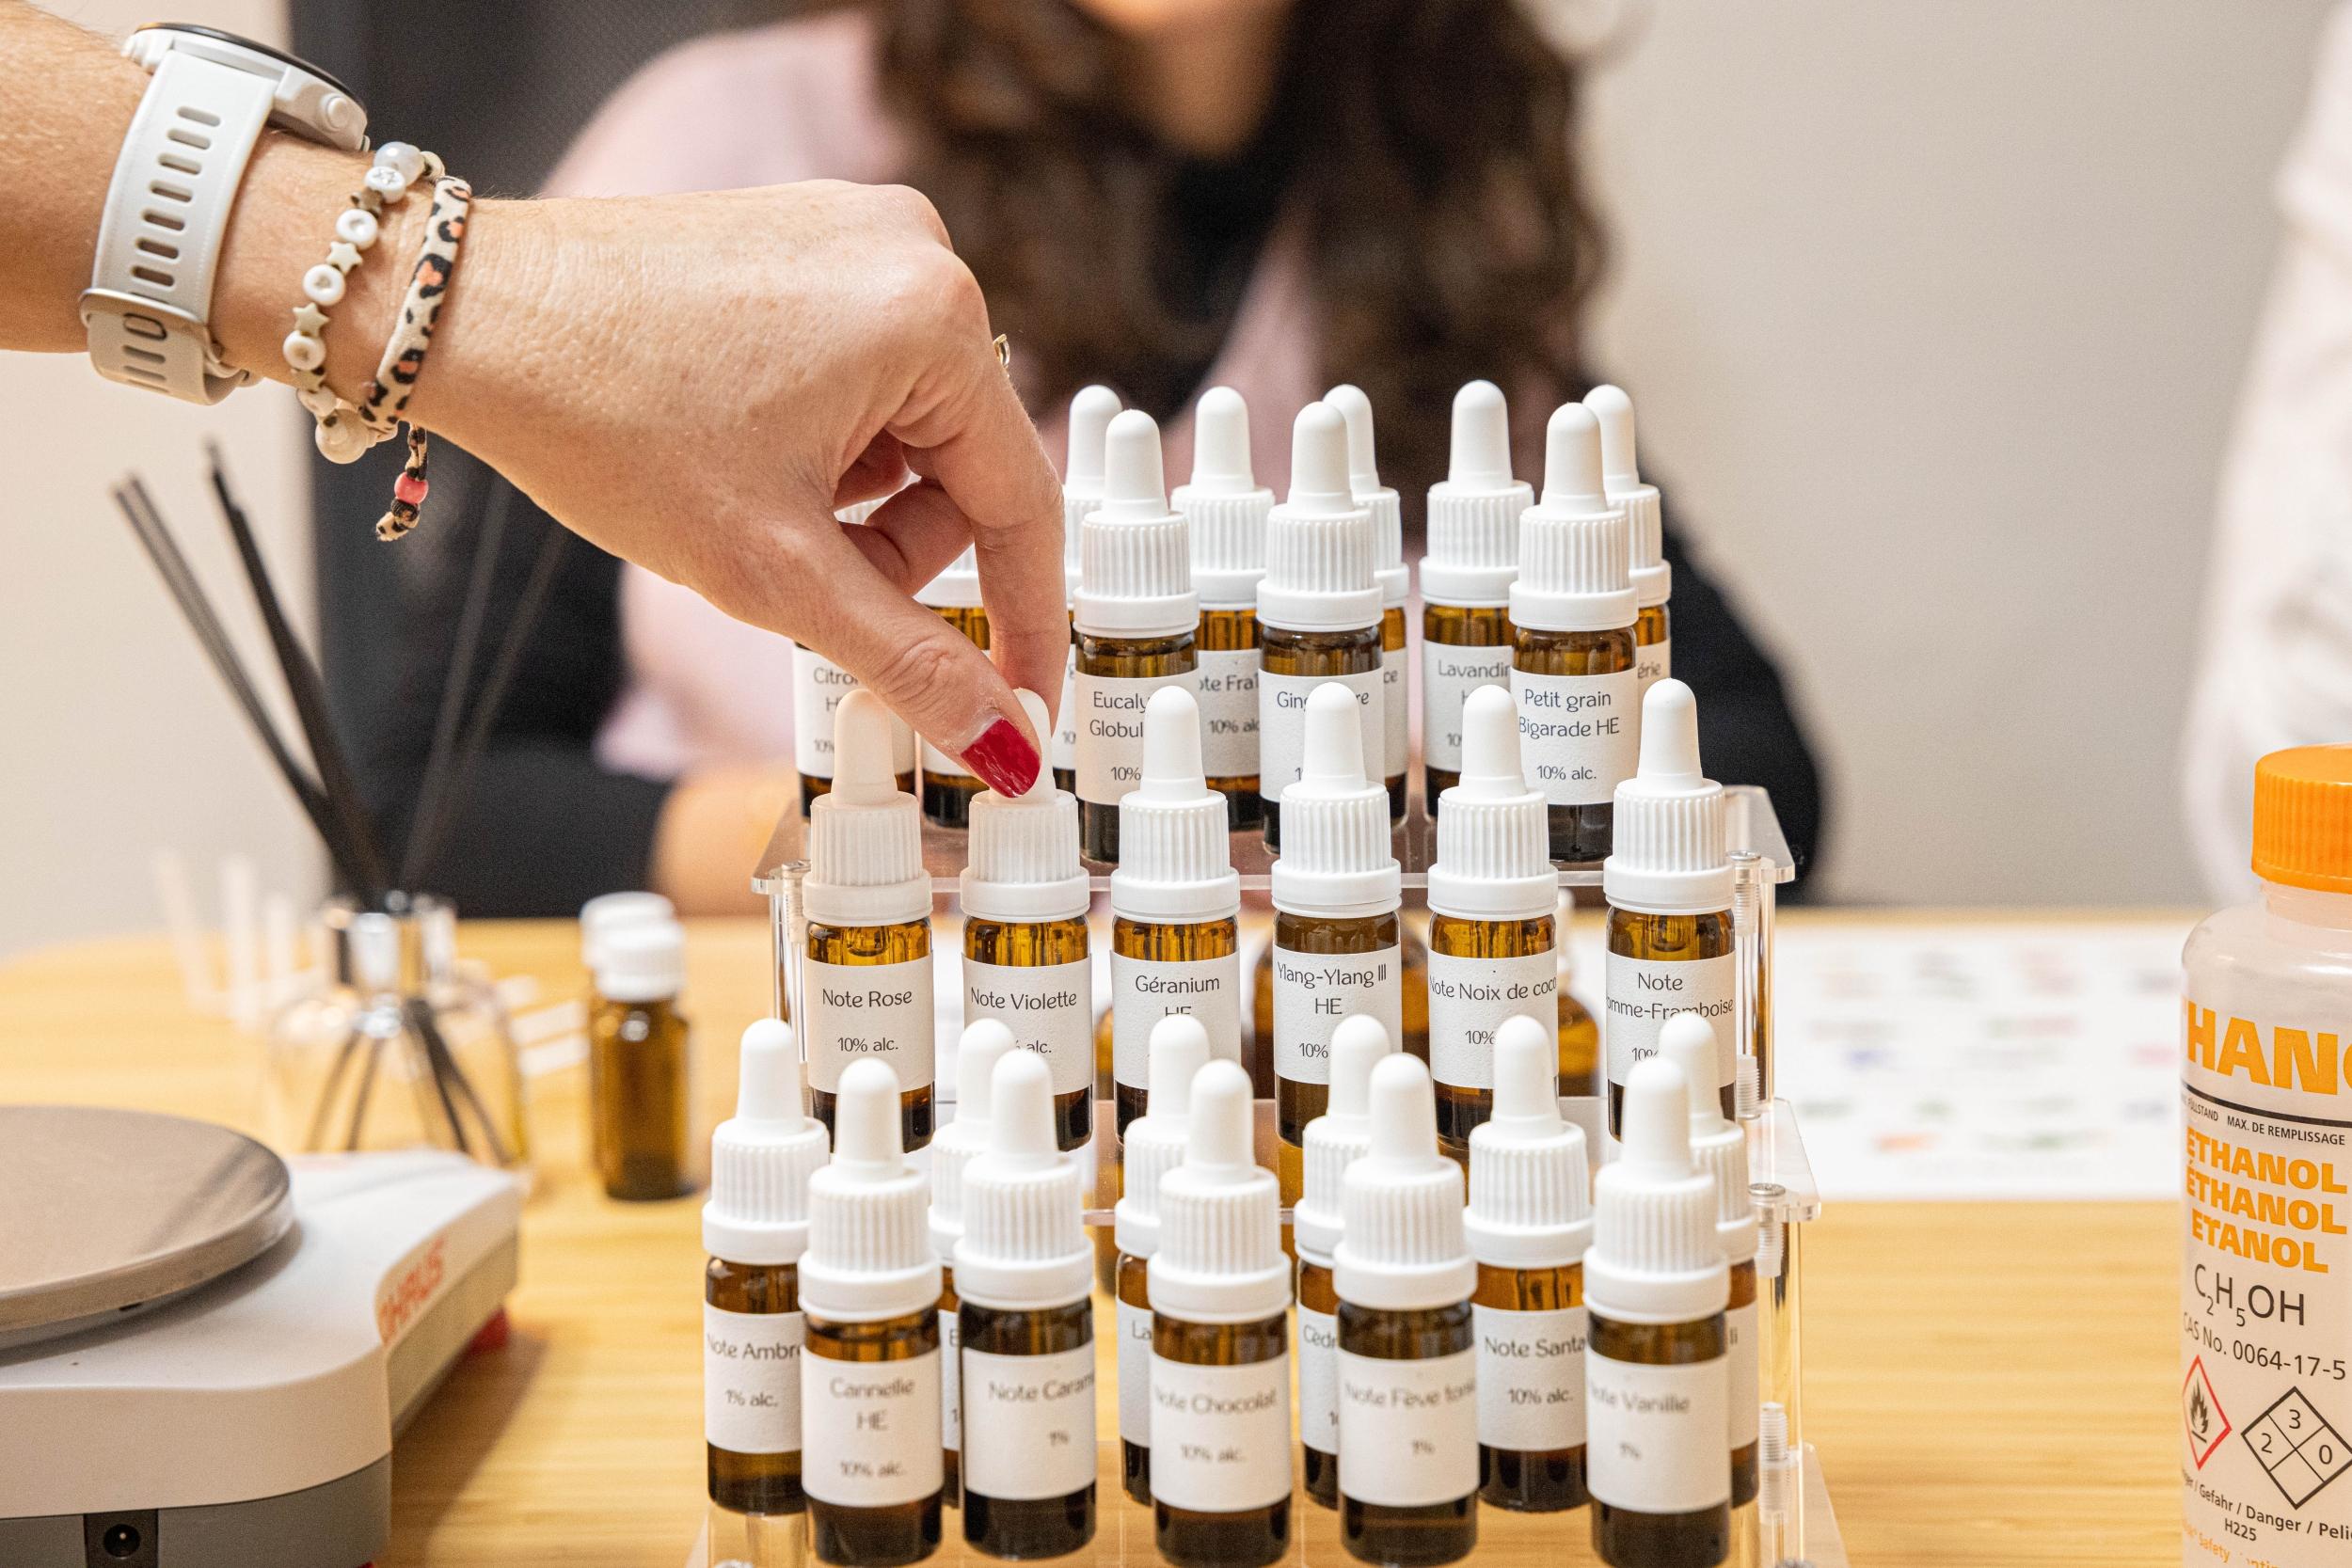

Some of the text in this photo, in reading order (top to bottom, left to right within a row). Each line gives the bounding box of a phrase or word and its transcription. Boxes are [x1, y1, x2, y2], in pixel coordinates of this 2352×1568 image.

[1637, 661, 1661, 679] érie
[1093, 691, 1150, 713] Eucaly
[1525, 689, 1612, 713] Petit grain
[1089, 719, 1143, 737] Globul
[1209, 720, 1238, 733] 10%
[1519, 716, 1620, 739] Bigarade HE
[1111, 767, 1141, 781] 10%
[1537, 766, 1597, 780] 10% alc.
[1136, 975, 1220, 993] Géranium
[1278, 961, 1375, 989] Ylang-Ylang
[1638, 973, 1683, 990] Note
[822, 988, 913, 1008] Note Rose
[971, 987, 1077, 1010] Note Violette
[1459, 983, 1501, 1001] Noix
[1506, 983, 1529, 1000] de
[1533, 976, 1557, 996] coco
[1315, 998, 1343, 1015] HE
[837, 1037, 898, 1053] 10% alc.
[1465, 1030, 1495, 1045] 10%
[1299, 1042, 1328, 1058] 10%
[2227, 1115, 2249, 1132] MAX.
[2252, 1122, 2265, 1135] DE
[2267, 1128, 2345, 1146] REMPLISSAGE
[2187, 1126, 2347, 1195] ETHANOL
[2186, 1158, 2347, 1235] ÉTHANOL
[2191, 1208, 2328, 1274] ETANOL
[1486, 1335, 1585, 1358] Note Santa
[2184, 1311, 2346, 1381] CAS No. 0064-17-5
[726, 1389, 778, 1407] 1% alc.
[829, 1376, 915, 1399] Cannelle
[989, 1380, 1038, 1402] Note
[1508, 1387, 1573, 1405] 10% alc.
[1192, 1386, 1277, 1414] Chocolat
[856, 1410, 888, 1431] HE
[2289, 1409, 2301, 1429] 3
[2261, 1433, 2333, 1465] 2 0
[2200, 1483, 2233, 1512] Gefahr
[2246, 1505, 2301, 1532] Danger
[2319, 1522, 2352, 1541] Peli
[2224, 1518, 2257, 1542] H225
